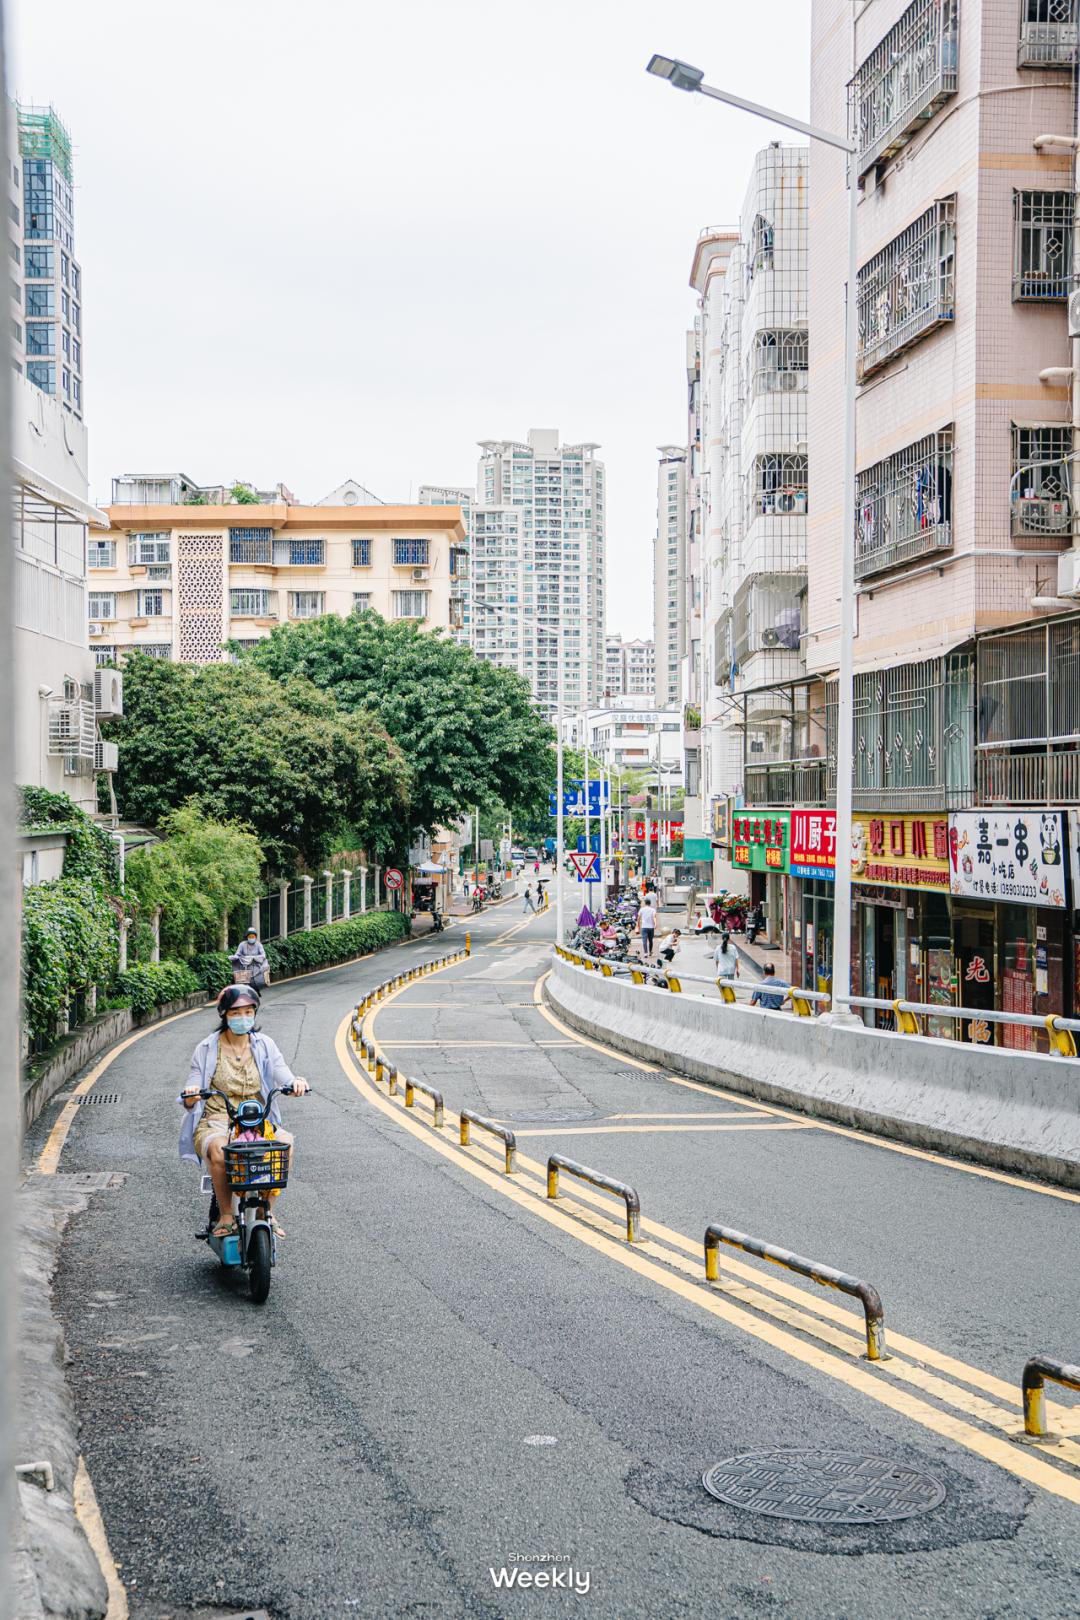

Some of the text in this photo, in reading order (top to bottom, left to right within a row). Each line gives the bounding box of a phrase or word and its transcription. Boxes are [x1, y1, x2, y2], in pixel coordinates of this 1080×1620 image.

[794, 815, 836, 852] 川厨子
[976, 817, 1029, 867] 嘉一串
[578, 857, 588, 867] 让
[991, 860, 1015, 879] 小吃店
